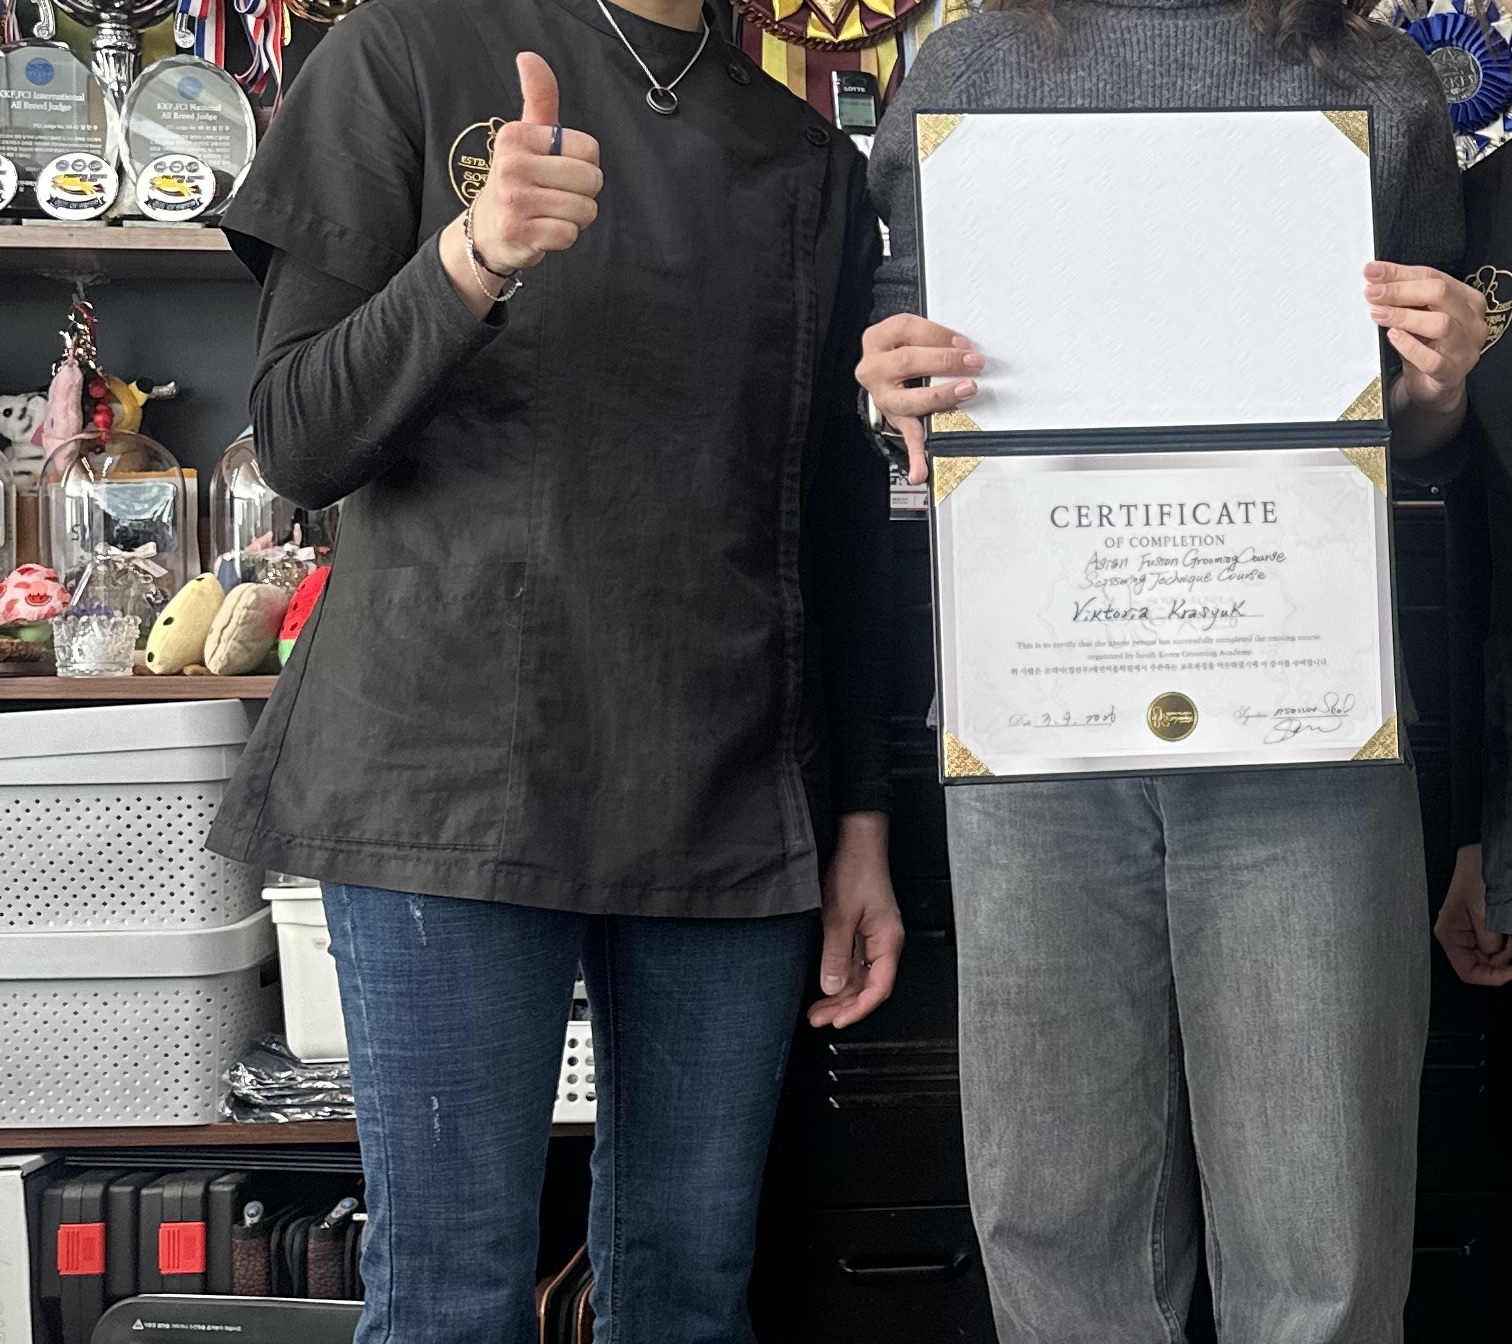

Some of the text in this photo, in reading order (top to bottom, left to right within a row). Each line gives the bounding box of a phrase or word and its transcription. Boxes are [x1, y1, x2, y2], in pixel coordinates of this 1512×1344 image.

[33, 92, 85, 102] International
[11, 101, 72, 112] All Breed Judge
[190, 103, 221, 112] National
[173, 112, 195, 120] Breed
[196, 112, 218, 122] Judge
[1050, 500, 1278, 529] CERTIFICATE
[1104, 534, 1226, 549] OF COMPLETION
[1217, 566, 1268, 582] Course
[1016, 641, 1034, 650] This
[1052, 641, 1076, 650] certify
[1078, 640, 1093, 648] that
